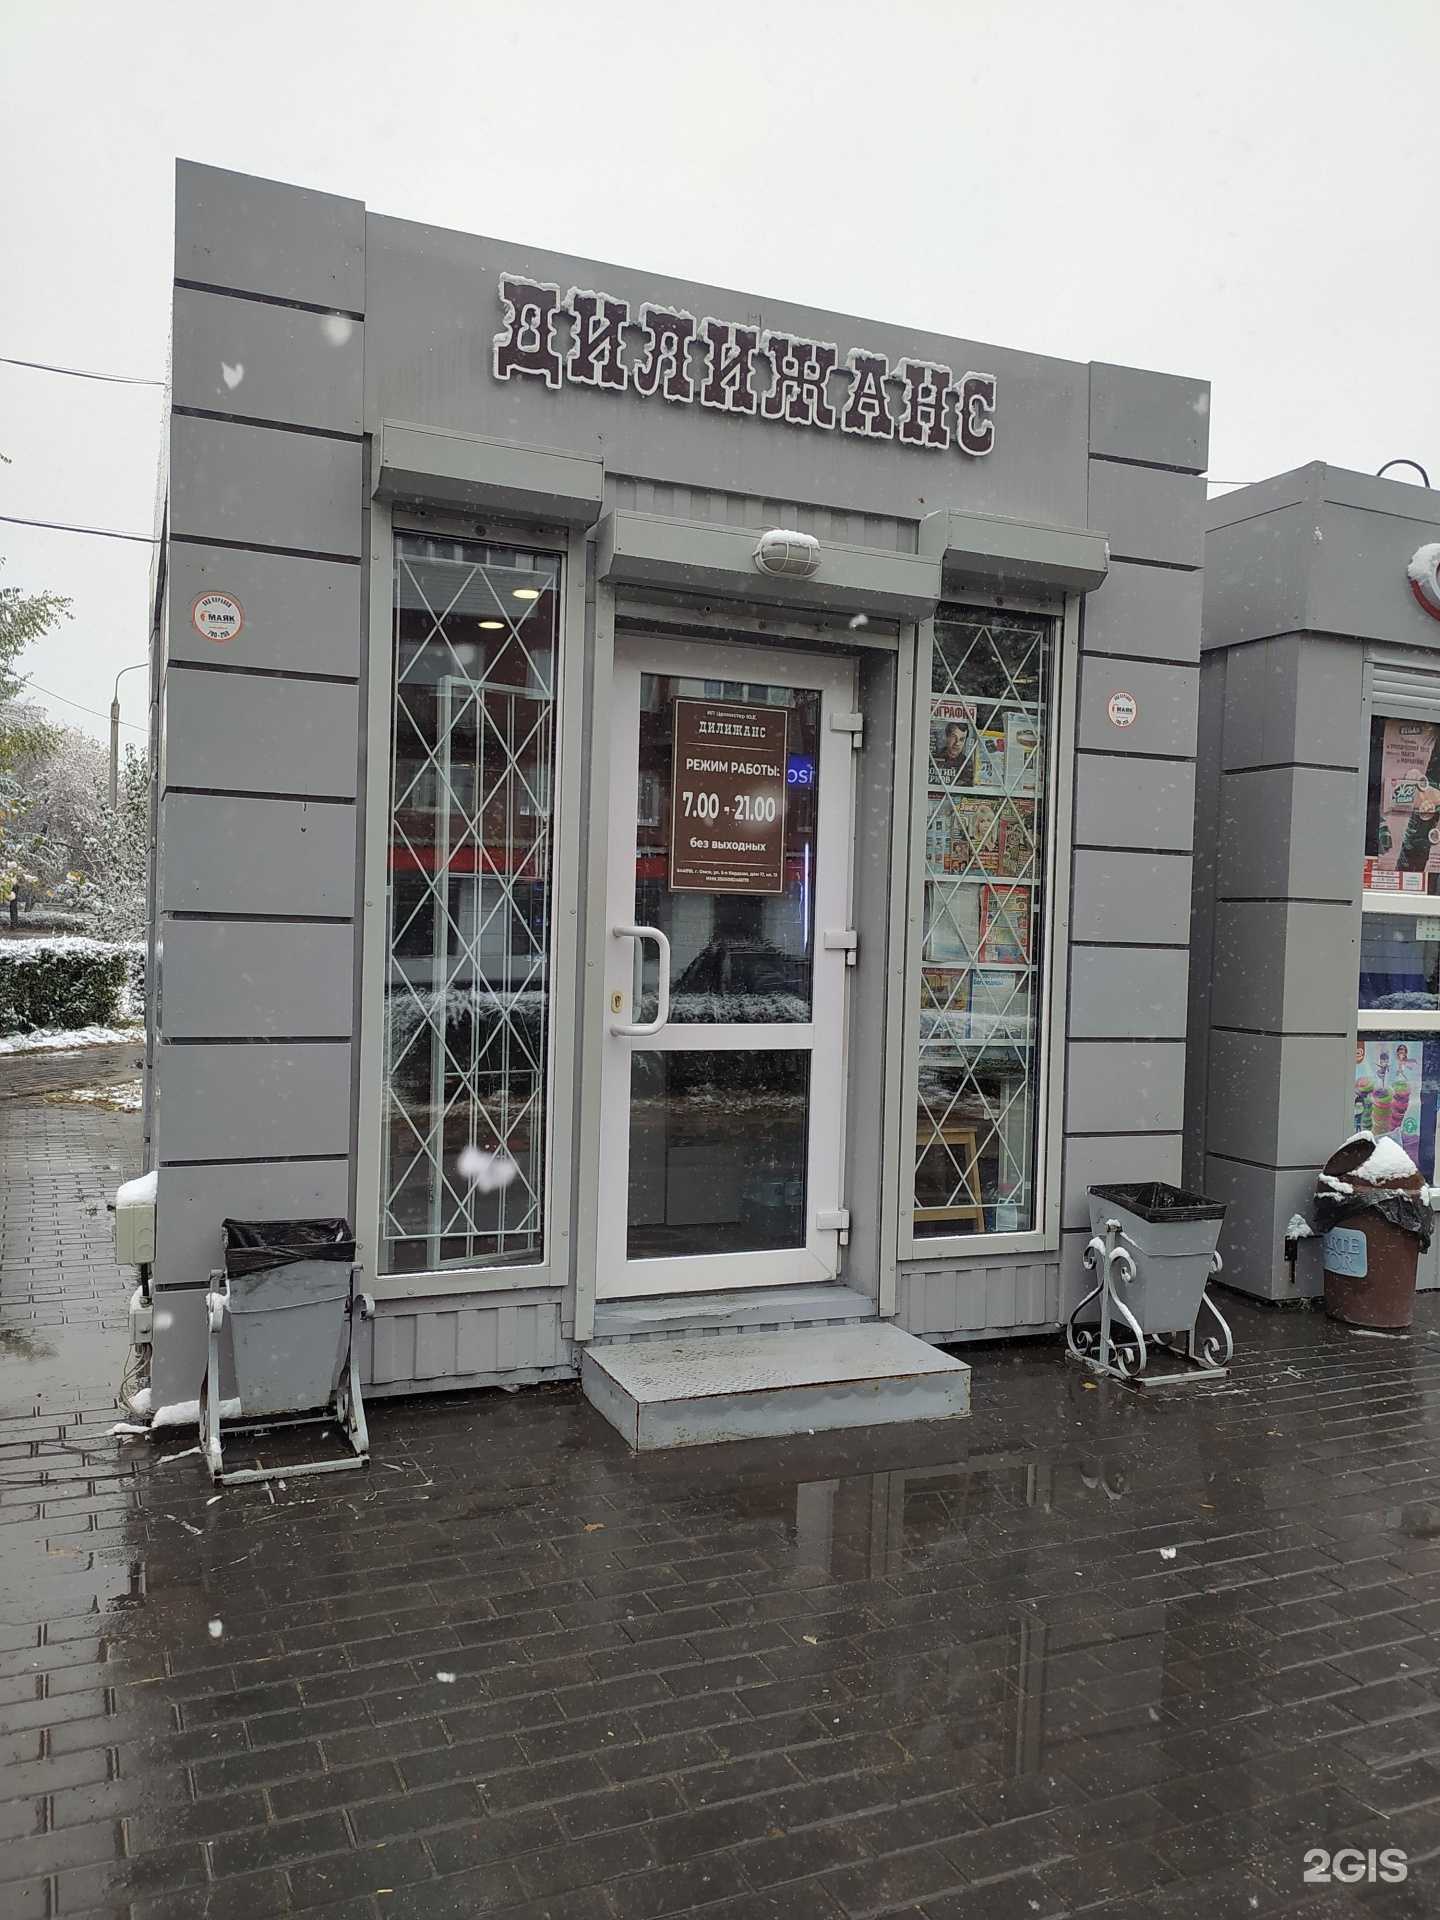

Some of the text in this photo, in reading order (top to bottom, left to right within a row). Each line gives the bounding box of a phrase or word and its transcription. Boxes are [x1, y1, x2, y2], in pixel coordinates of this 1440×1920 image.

[493, 273, 997, 456] ДИЛИЖАНС
[208, 614, 235, 622] МАЯК
[699, 721, 766, 738] ДИЛИЖАНС
[686, 758, 781, 777] РЕЖИМ РАБОТЫ:
[682, 791, 720, 819] 7.00
[734, 794, 776, 822] 21.00
[690, 837, 767, 852] без выходных
